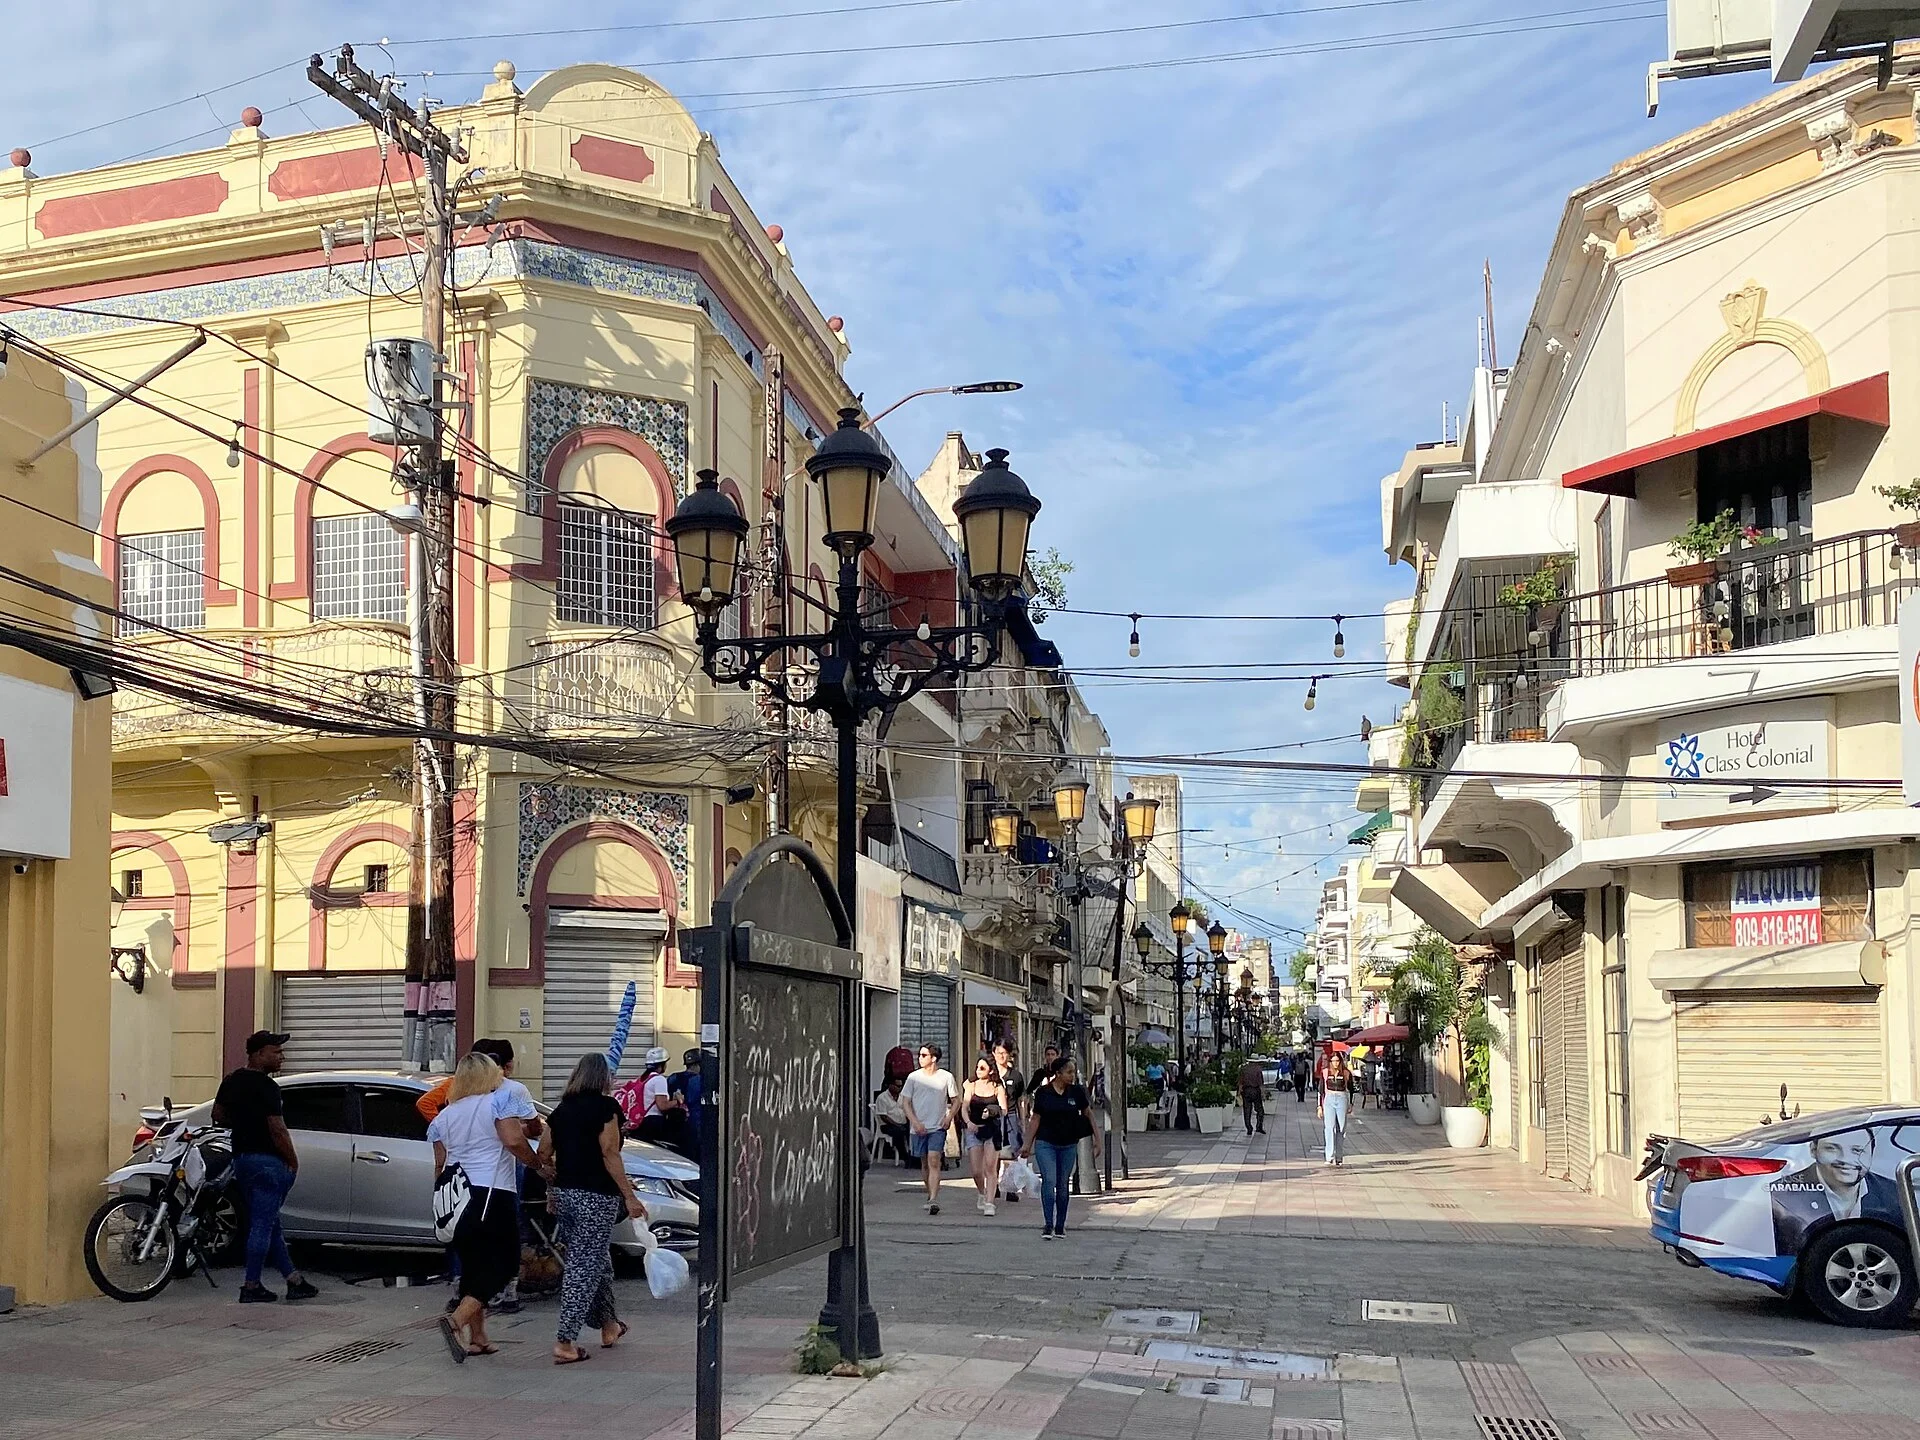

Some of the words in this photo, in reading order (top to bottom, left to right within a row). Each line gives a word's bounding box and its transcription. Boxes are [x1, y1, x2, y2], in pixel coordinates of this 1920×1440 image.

[1727, 726, 1766, 749] Hotel
[1704, 756, 1741, 774] Class
[1746, 744, 1813, 769] Colonial
[1735, 866, 1817, 907] ALQUILO
[1735, 913, 1819, 947] 809-818-9514
